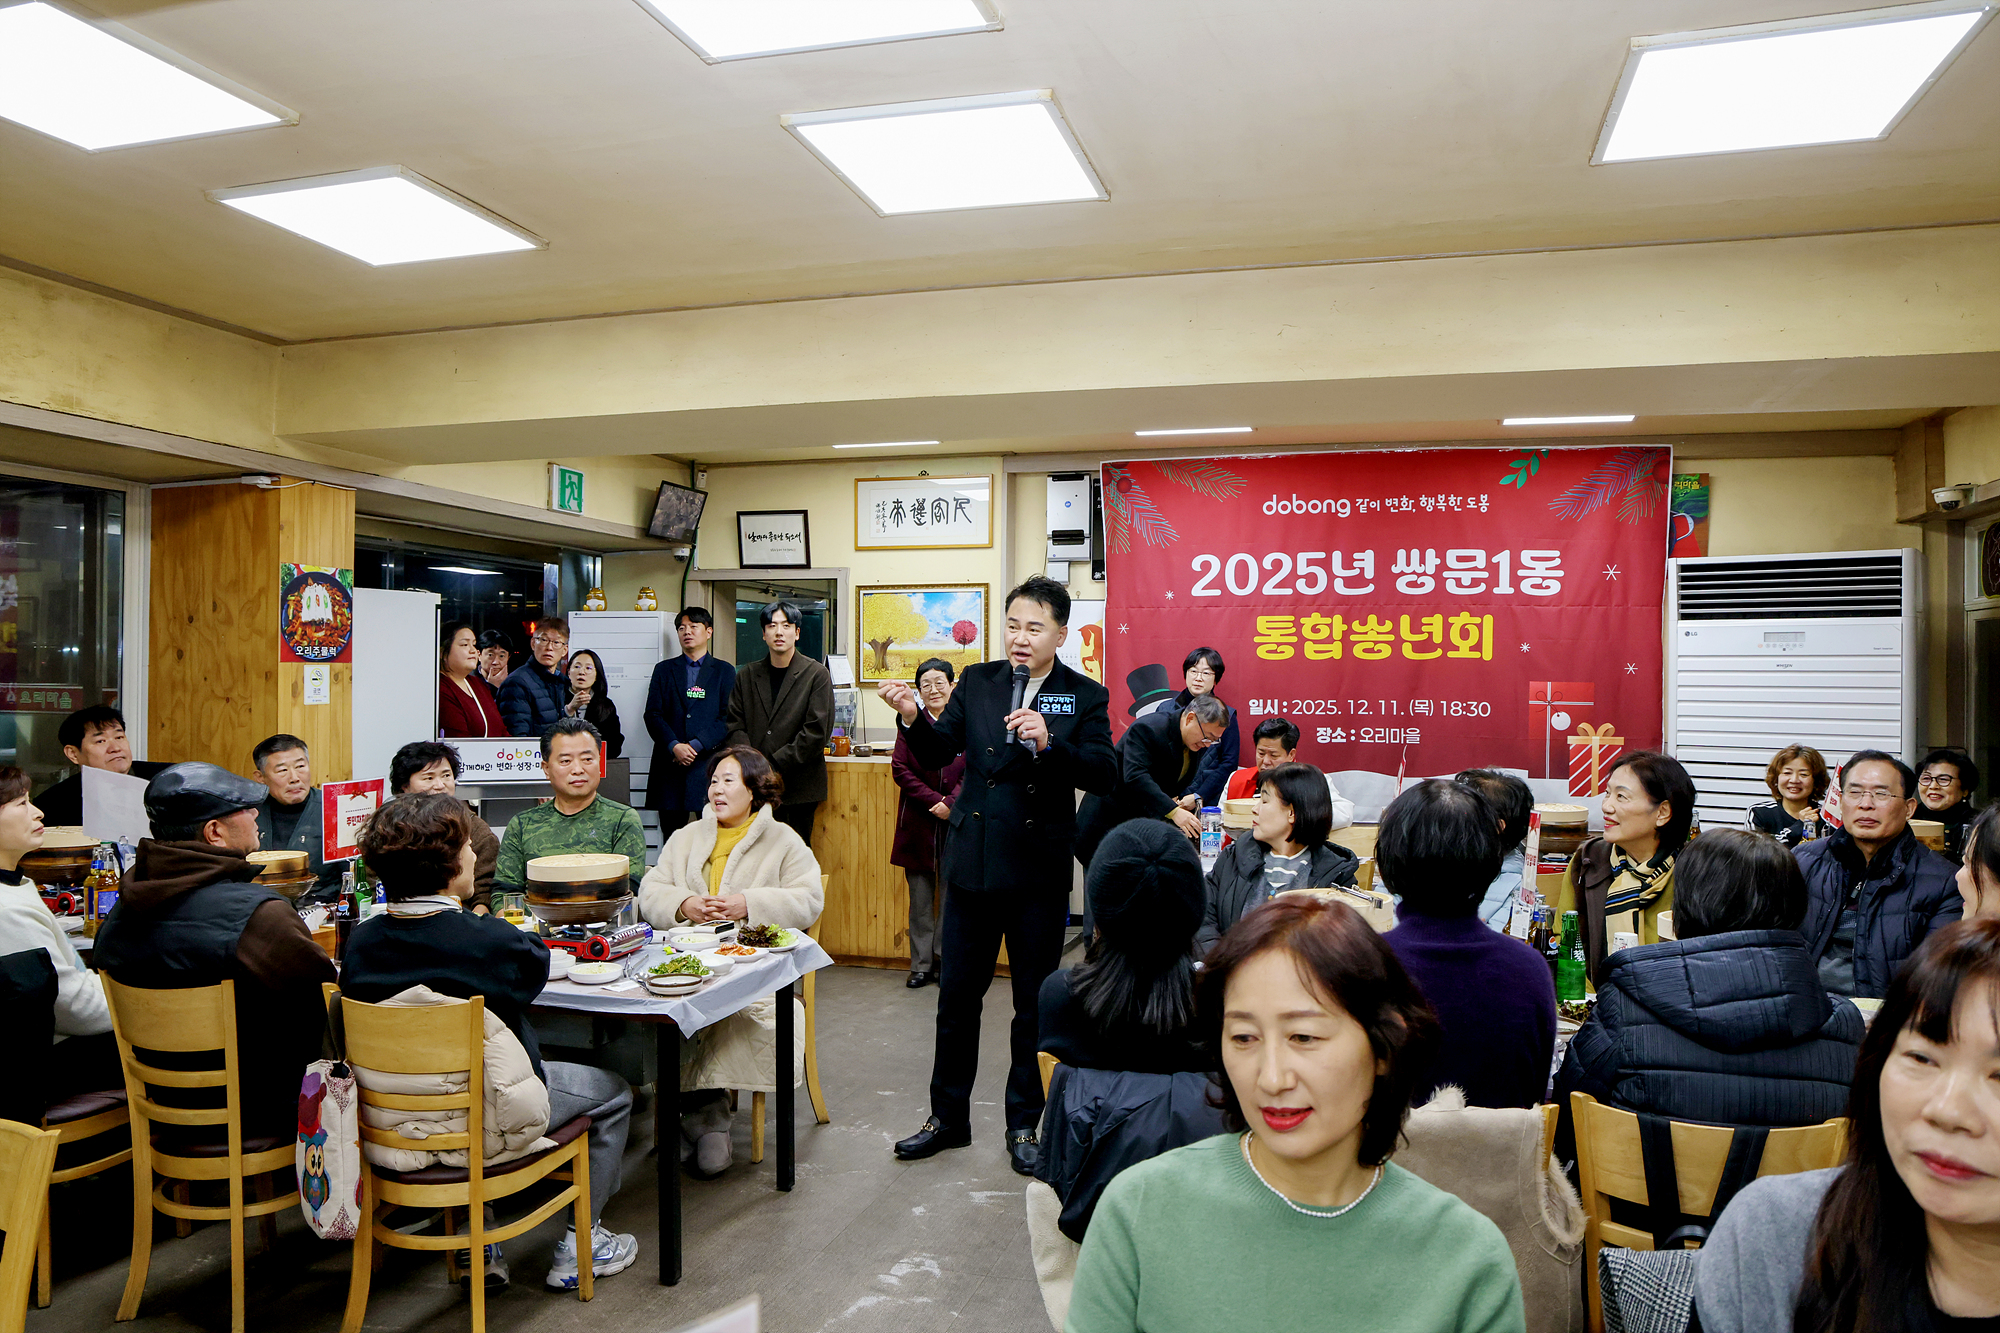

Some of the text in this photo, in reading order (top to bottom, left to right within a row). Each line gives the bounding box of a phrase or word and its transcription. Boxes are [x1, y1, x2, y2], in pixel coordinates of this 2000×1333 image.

[1674, 481, 1700, 490] 리마을
[1262, 493, 1351, 518] dobong
[1355, 494, 1490, 513] 같이 변화, 행복한 도봉
[1190, 548, 1565, 597] 2025년 쌍문1동
[1252, 611, 1494, 661] 통합송년회
[295, 645, 337, 657] 오리주물럭
[1040, 703, 1072, 713] 오언석
[1248, 699, 1278, 716] 일시
[1291, 699, 1342, 715] 2025.
[1347, 700, 1373, 715] 12.
[1378, 700, 1405, 716] 11.
[1409, 699, 1434, 716] (목)
[1440, 700, 1491, 717] 18:30
[1316, 727, 1346, 744] 장소
[1359, 728, 1421, 744] 오리마을
[497, 748, 542, 760] dobon
[1203, 840, 1220, 848] KRUSH
